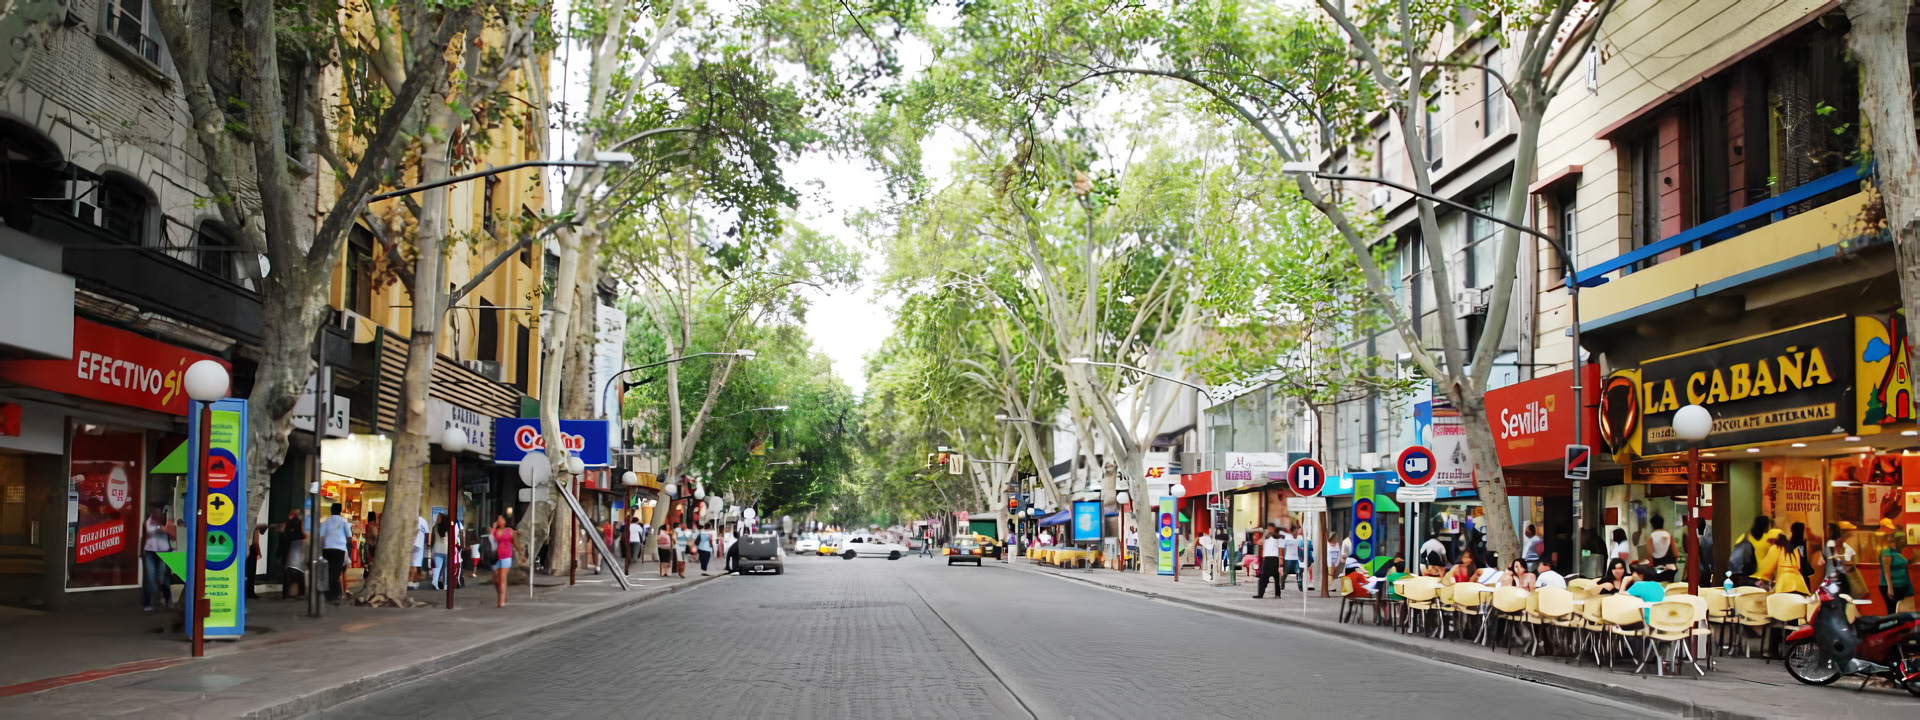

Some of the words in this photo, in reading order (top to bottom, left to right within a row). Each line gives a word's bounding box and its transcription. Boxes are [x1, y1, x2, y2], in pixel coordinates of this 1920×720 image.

[77, 350, 163, 395] EFECTIVO
[1643, 378, 1680, 415] LA
[1686, 345, 1834, 405] CABAÑA
[1500, 401, 1549, 439] Sevilla
[1298, 466, 1315, 489] H
